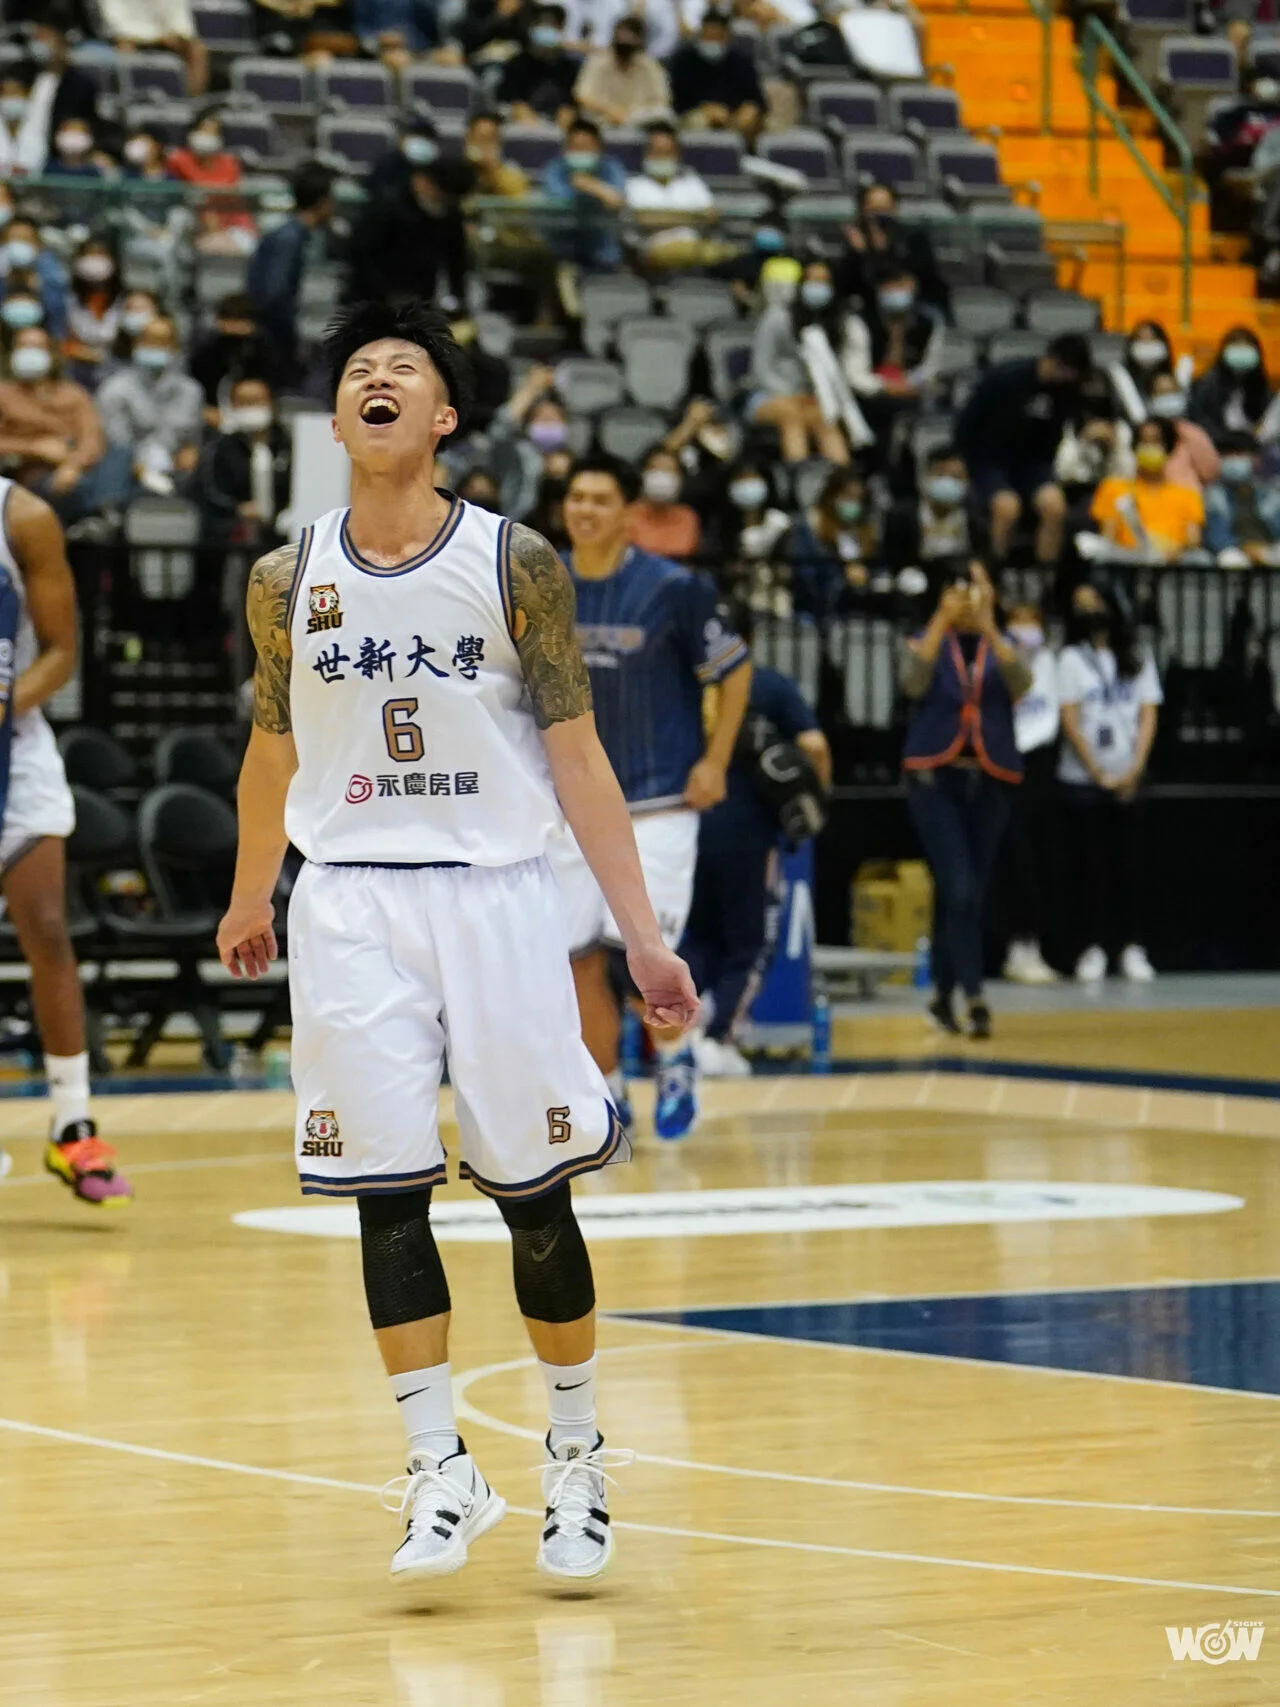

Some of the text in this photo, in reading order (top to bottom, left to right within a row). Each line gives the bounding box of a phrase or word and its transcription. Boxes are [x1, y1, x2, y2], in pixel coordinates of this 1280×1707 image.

[306, 612, 344, 634] SHU
[312, 635, 485, 684] 世新大學
[382, 697, 425, 763] 6
[375, 771, 480, 797] 永慶房屋
[547, 1105, 571, 1145] 6
[300, 1140, 345, 1158] SHU
